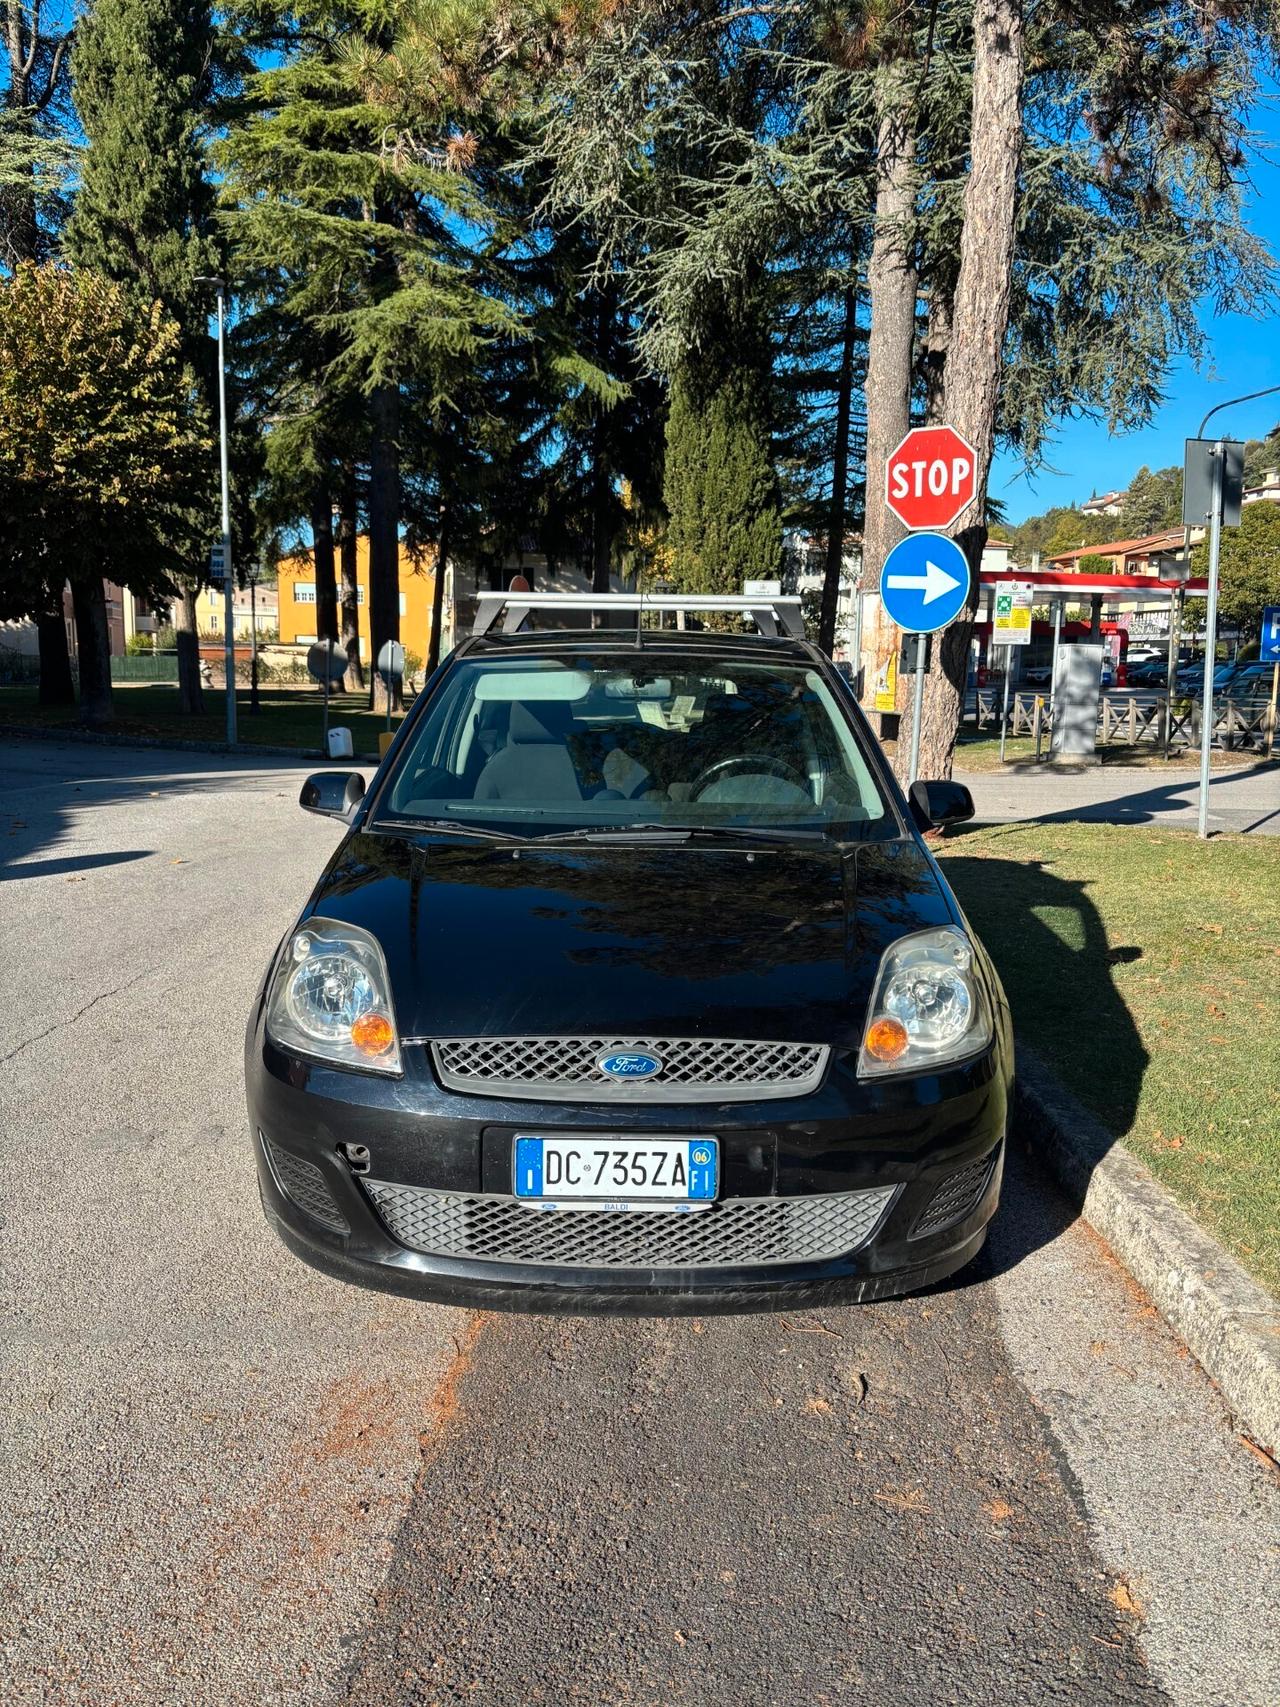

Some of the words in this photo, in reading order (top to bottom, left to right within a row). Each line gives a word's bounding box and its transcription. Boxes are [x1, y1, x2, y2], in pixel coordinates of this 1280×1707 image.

[891, 457, 970, 499] STOP
[612, 1055, 647, 1072] Ford
[695, 1151, 708, 1162] 06
[593, 1151, 687, 1187] 735ZA
[527, 1169, 533, 1190] I
[604, 1203, 629, 1211] BALDI
